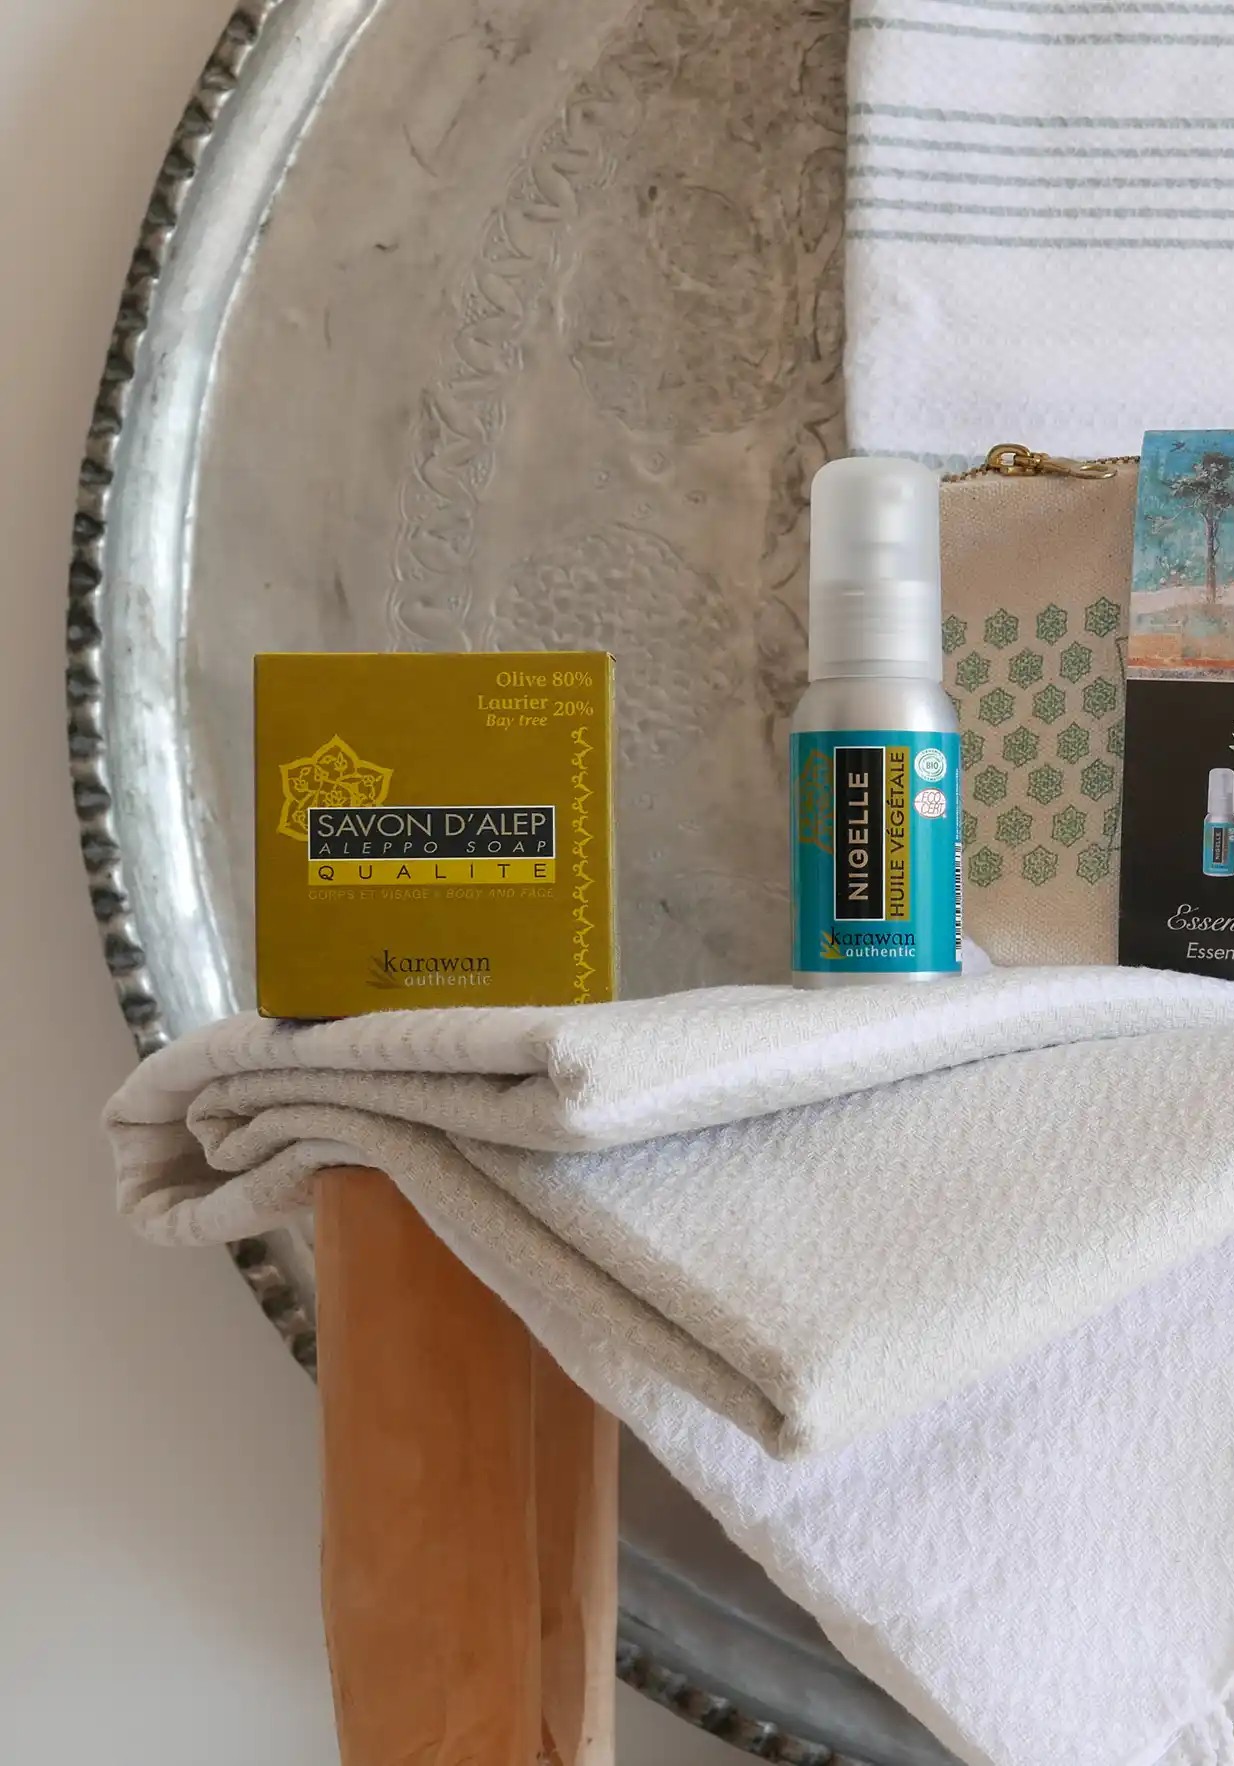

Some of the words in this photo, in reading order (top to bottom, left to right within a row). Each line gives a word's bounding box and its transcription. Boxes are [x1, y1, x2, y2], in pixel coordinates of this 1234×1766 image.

[496, 671, 547, 687] Olive
[552, 671, 593, 687] 80%
[477, 694, 549, 710] Laurier
[552, 700, 594, 716] 20%
[486, 713, 514, 731] Bay
[519, 714, 548, 727] tree
[926, 761, 939, 770] BIO
[886, 751, 905, 854] VÉGÉTALE
[922, 791, 941, 803] ECO
[921, 802, 945, 815] CERT
[317, 813, 432, 837] SAVON
[445, 812, 547, 836] D'ALEP
[848, 772, 869, 901] NIGELLE
[318, 841, 438, 855] ALEPPO
[466, 840, 547, 854] SOAP
[318, 863, 547, 881] QUALITE
[308, 889, 355, 900] CORPS
[360, 889, 376, 900] ET
[381, 889, 430, 900] VISAGE
[446, 888, 483, 899] BODY
[489, 888, 515, 899] AND
[520, 888, 553, 899] FACE
[889, 861, 905, 917] HUILE
[830, 927, 915, 946] karawan
[383, 949, 491, 973] karawan
[846, 946, 916, 958] authentic
[404, 972, 493, 987] authentic
